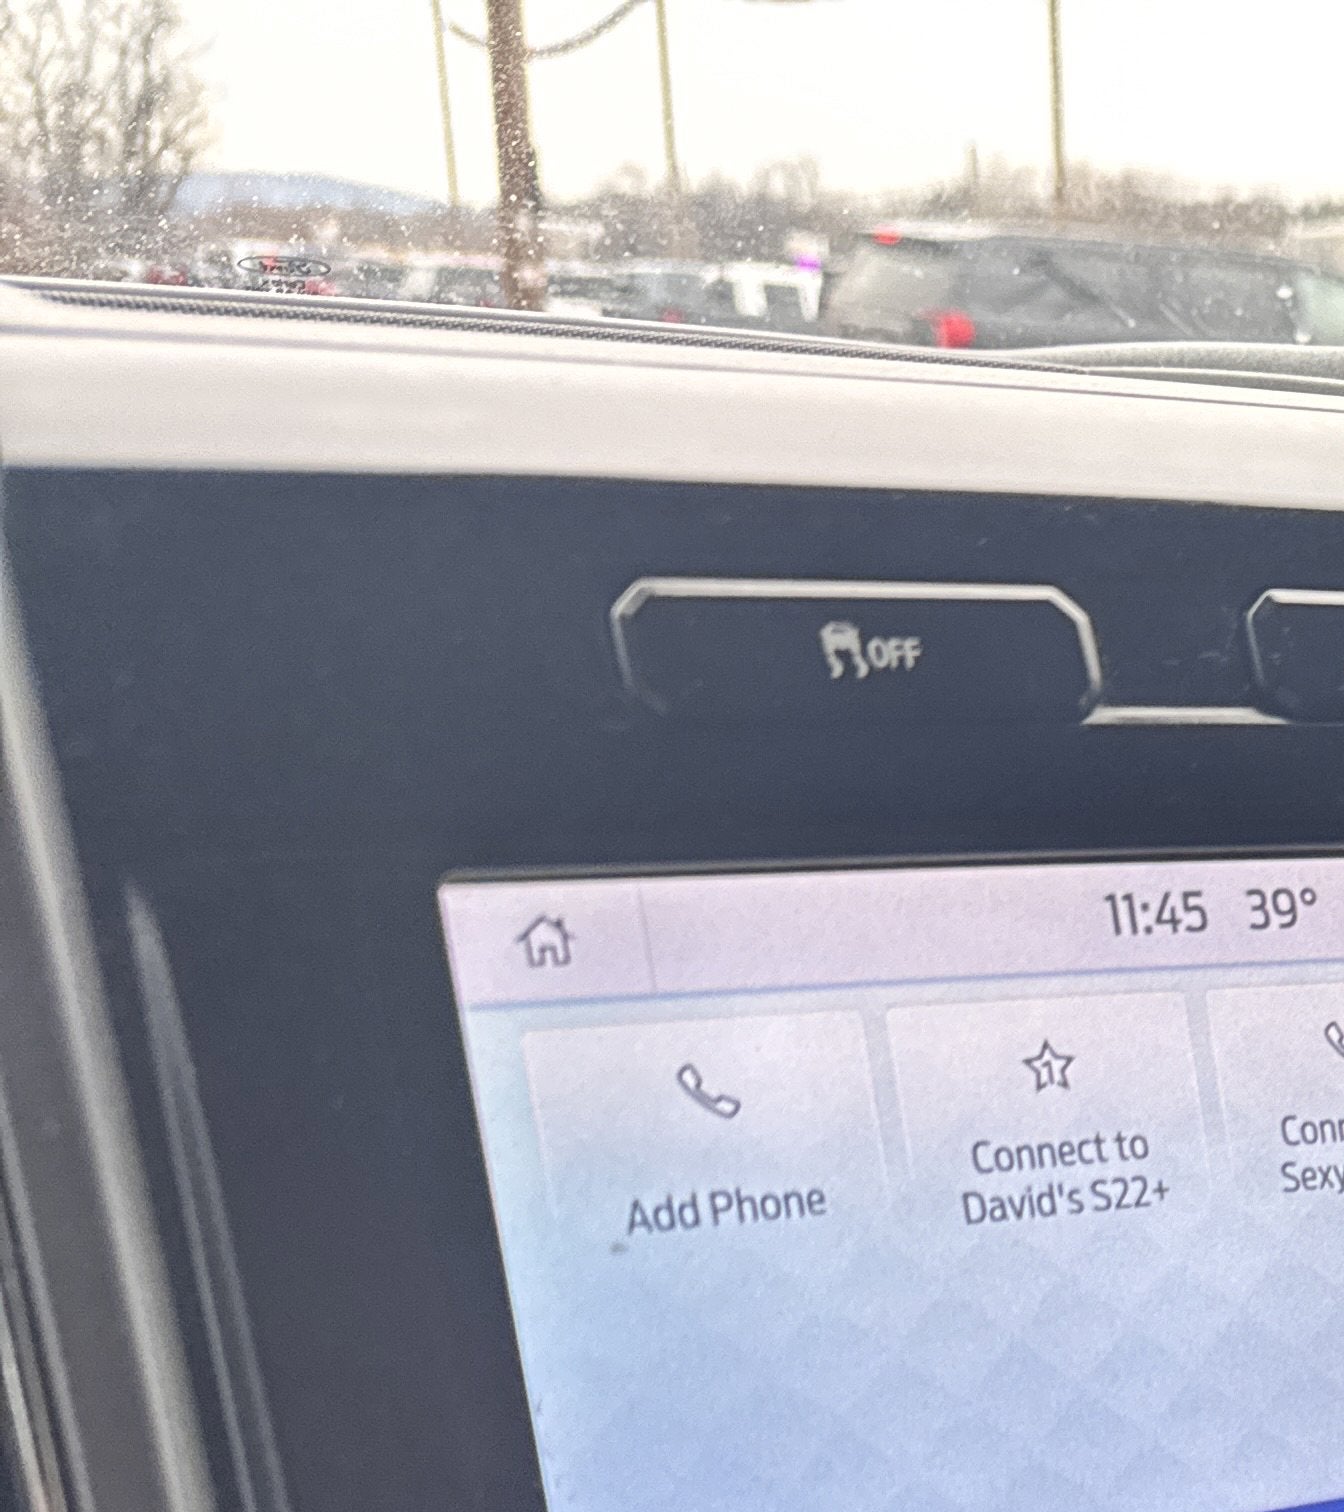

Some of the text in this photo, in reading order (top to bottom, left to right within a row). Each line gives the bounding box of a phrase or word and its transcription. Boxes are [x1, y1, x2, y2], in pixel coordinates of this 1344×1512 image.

[866, 636, 922, 671] OFF
[1104, 887, 1317, 936] 11:45 39°
[972, 1130, 1149, 1175] Connect to
[628, 1187, 827, 1235] Add Phone
[962, 1175, 1170, 1226] David's S22+
